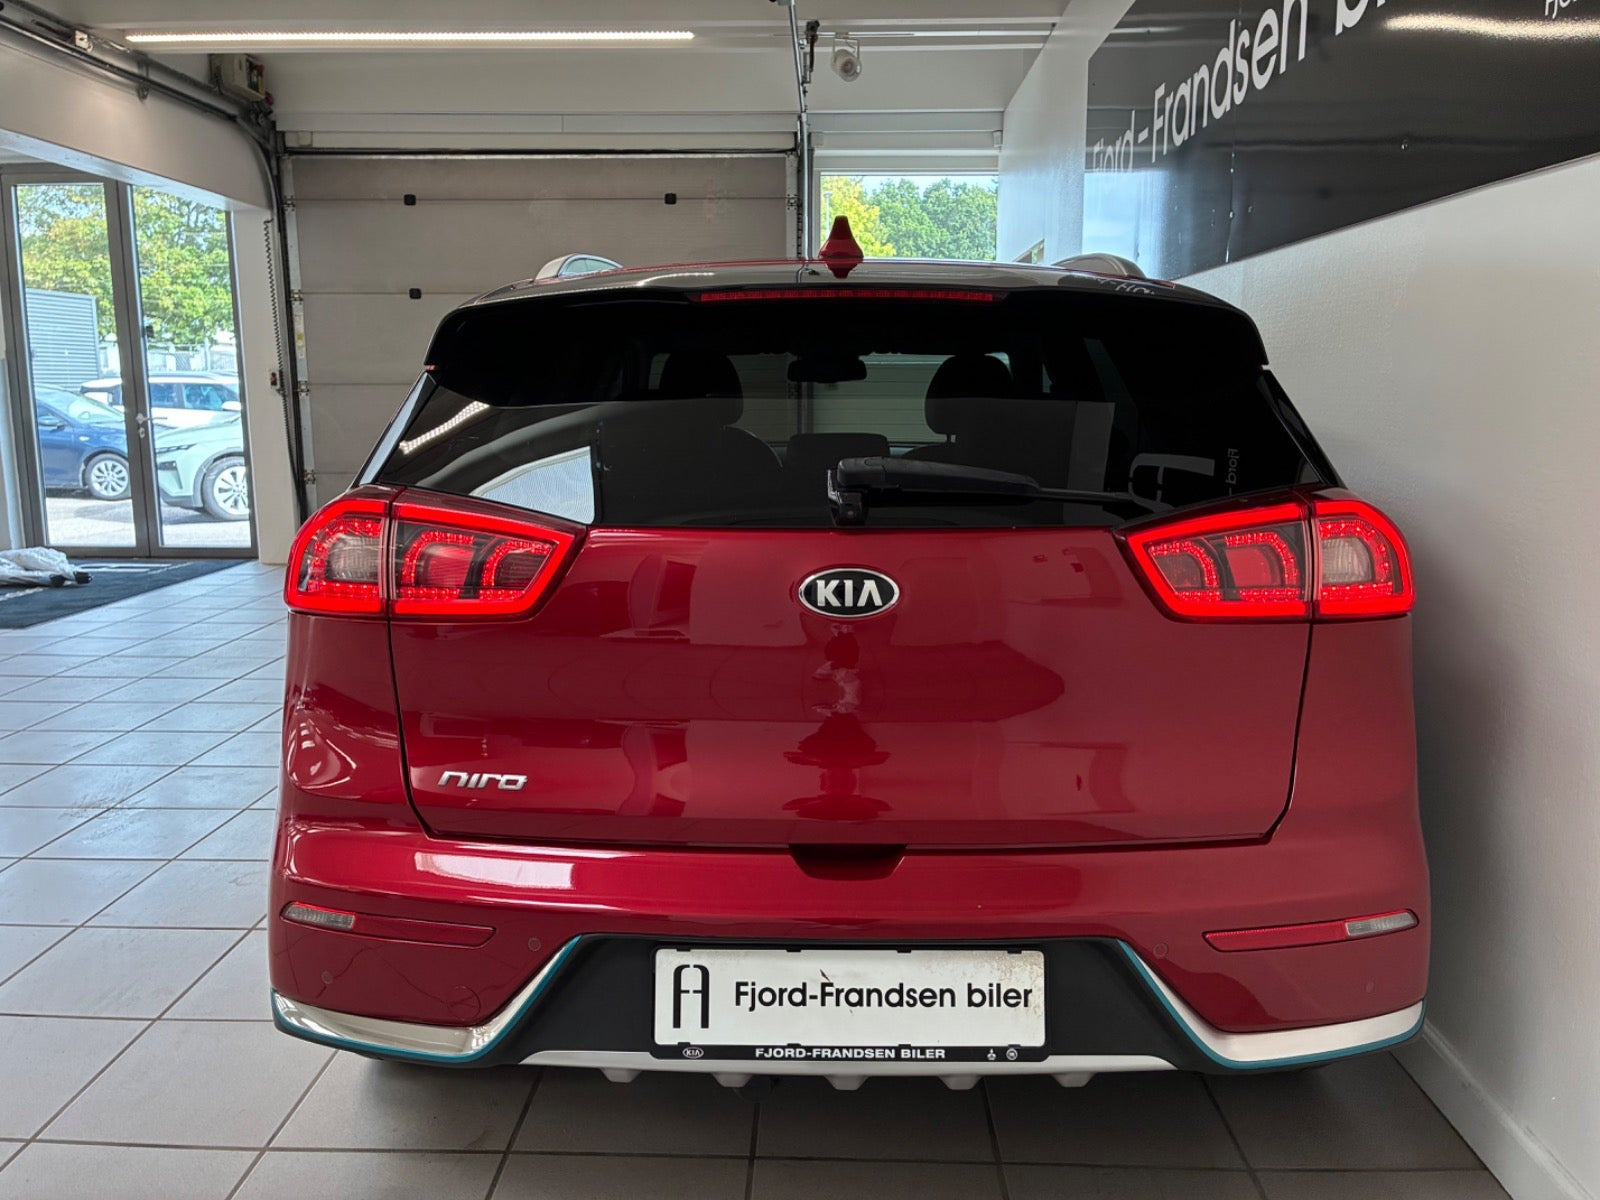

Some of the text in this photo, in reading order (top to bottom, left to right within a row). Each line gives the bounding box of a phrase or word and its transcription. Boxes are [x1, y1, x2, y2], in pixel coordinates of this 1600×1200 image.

[816, 579, 883, 607] KIA
[735, 981, 956, 1012] Fjord-Frandsen
[967, 982, 1033, 1008] biler
[755, 1047, 895, 1059] FJORD-FRANDSEN
[901, 1047, 946, 1059] BILER
